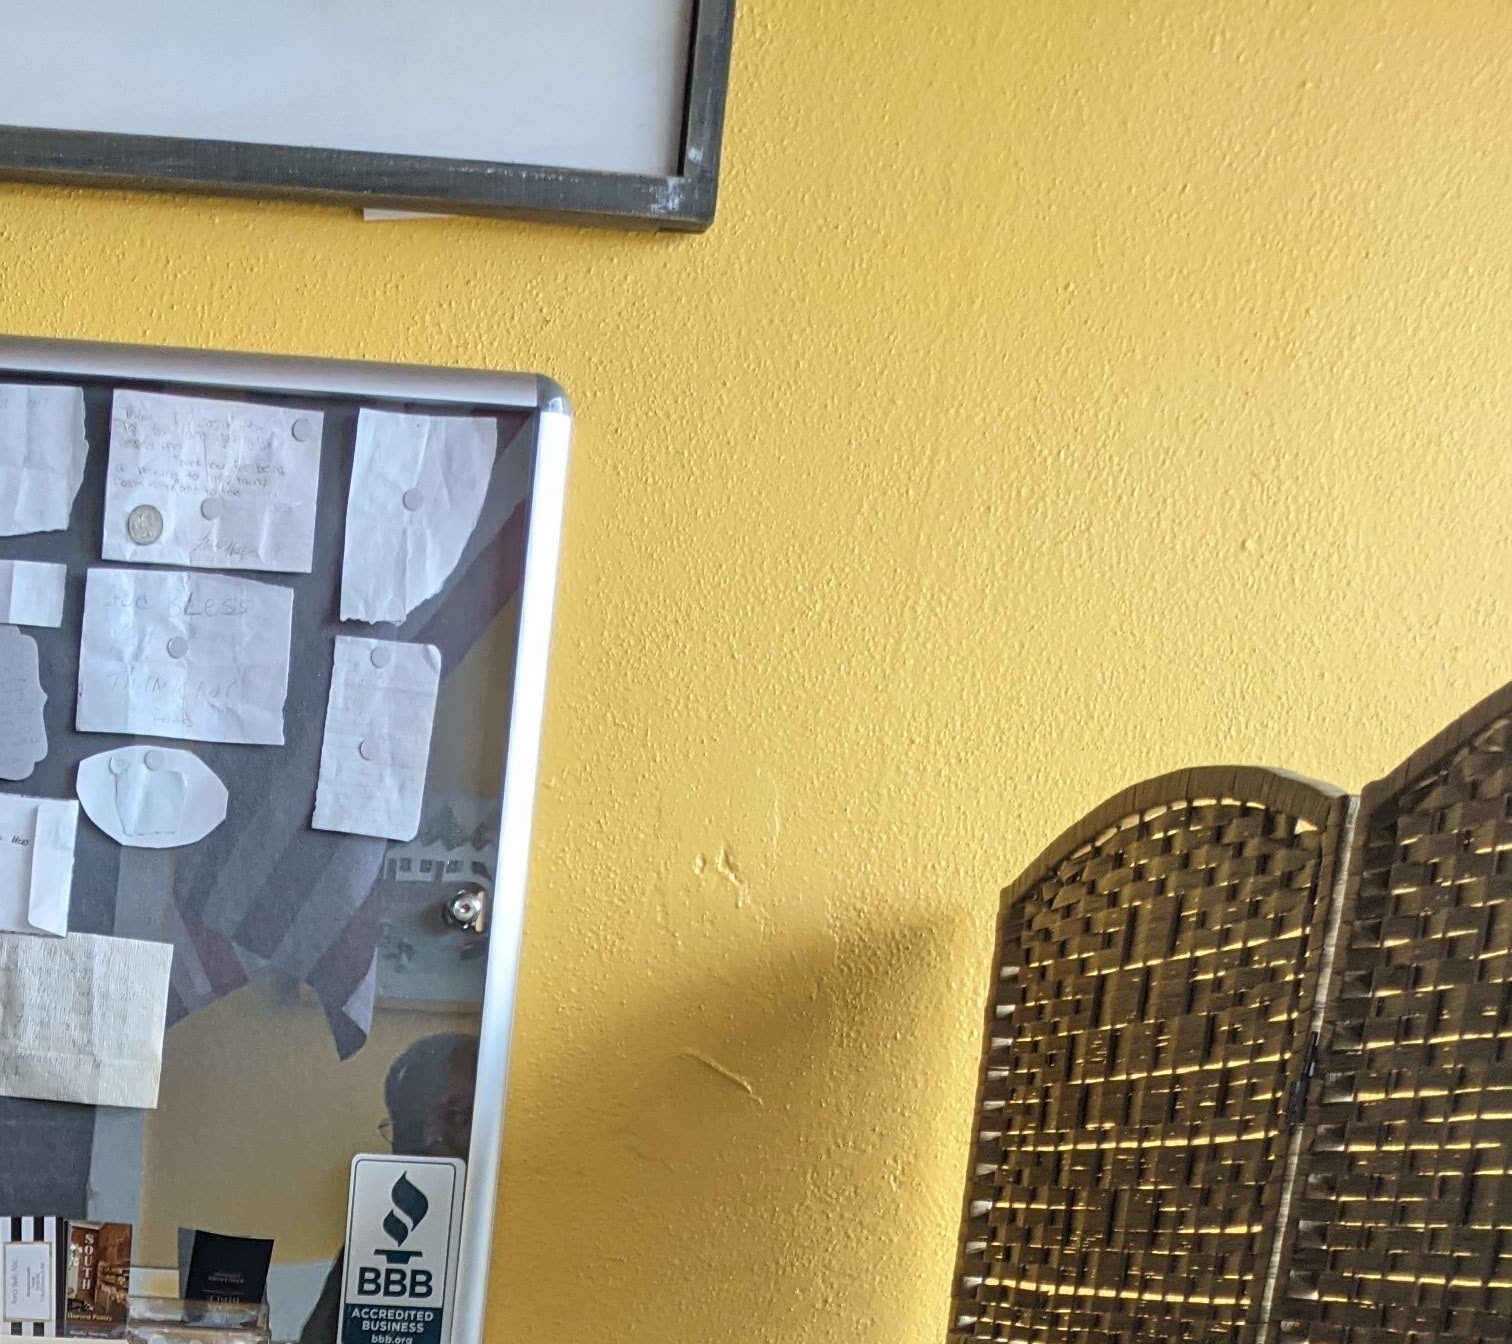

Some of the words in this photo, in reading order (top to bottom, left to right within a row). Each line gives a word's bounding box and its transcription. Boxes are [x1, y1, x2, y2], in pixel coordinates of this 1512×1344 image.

[81, 1233, 95, 1290] SOUTH
[357, 1266, 433, 1298] BBB
[351, 1307, 434, 1322] ACCREDITED
[361, 1320, 424, 1333] BUSINESS
